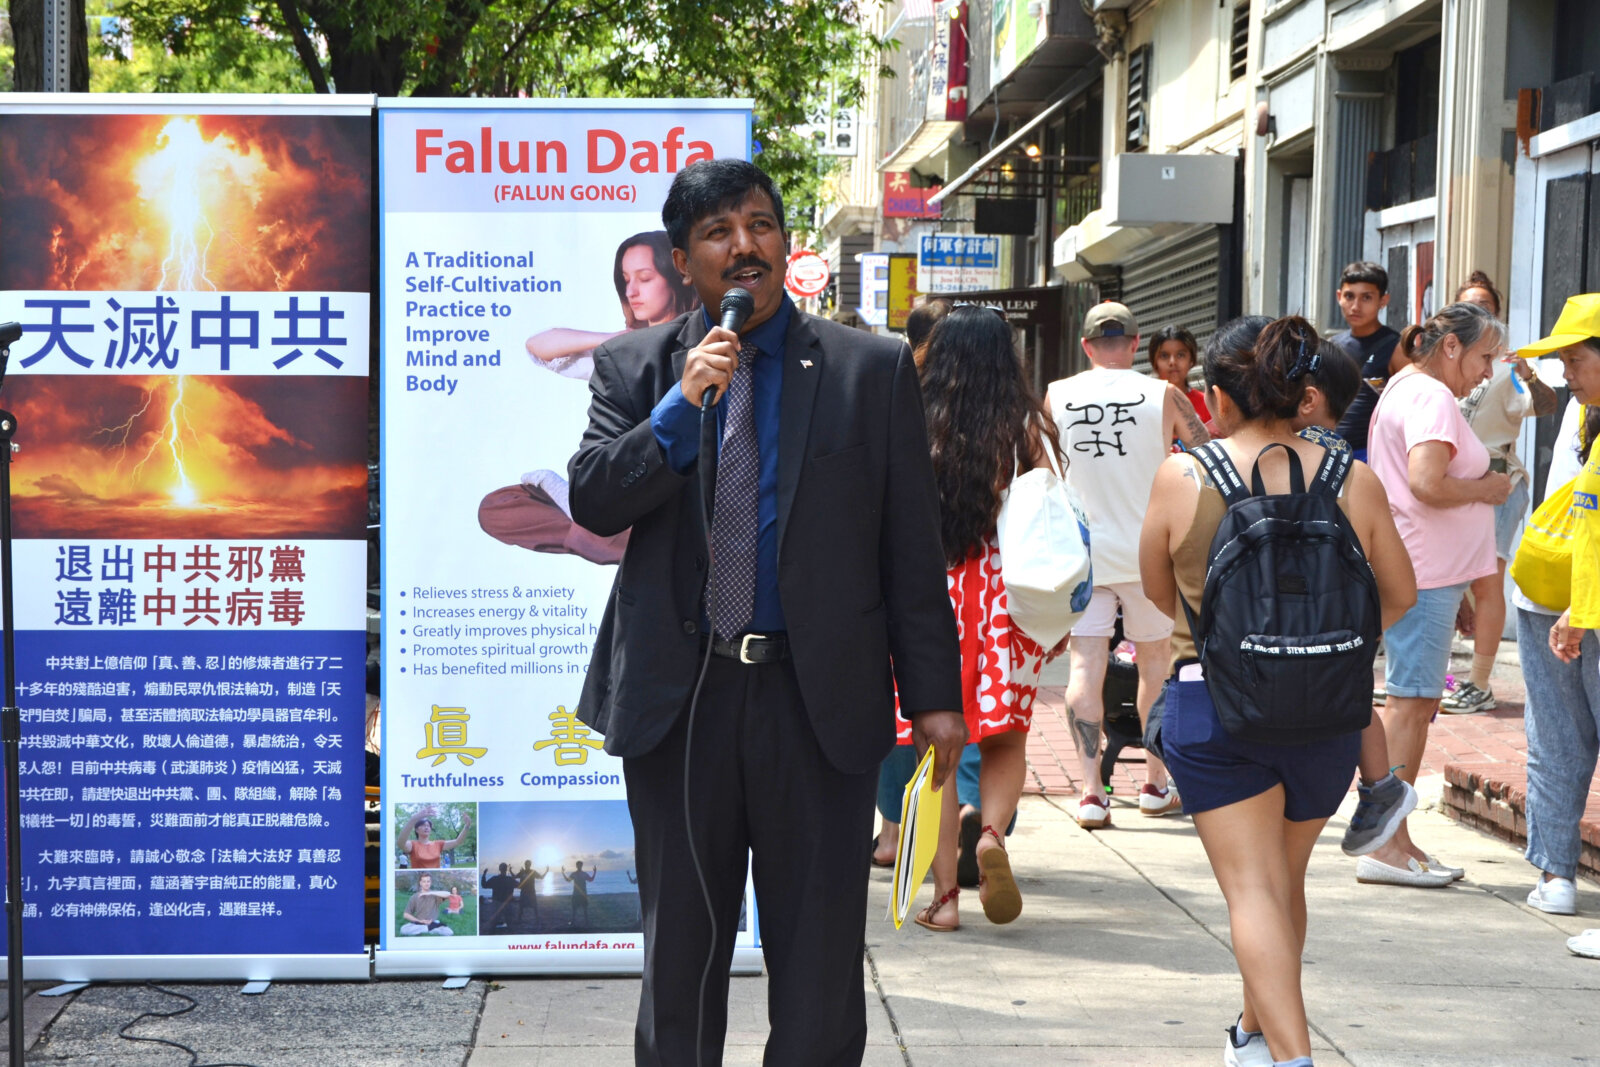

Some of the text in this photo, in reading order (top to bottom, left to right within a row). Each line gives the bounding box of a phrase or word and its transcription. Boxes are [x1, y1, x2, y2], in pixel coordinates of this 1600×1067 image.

[416, 126, 714, 173] Falun Dafa
[495, 185, 636, 202] (FALUN GONG)
[406, 251, 533, 268] A Traditional
[406, 276, 561, 292] Self-Cultivation
[406, 300, 511, 317] Practice to
[954, 299, 1038, 310] BNANA LEAF
[19, 296, 347, 371] 天滅中共
[407, 326, 489, 346] Improve
[406, 350, 500, 366] Mind and
[407, 374, 458, 395] Body
[56, 545, 305, 582] 退出中共邪黨
[414, 586, 574, 600] Relieves stress & anxiety
[55, 588, 304, 625] 遠離中共病毒
[414, 604, 587, 620] Increases energy & vitality
[413, 624, 461, 639] Greatly
[465, 625, 527, 638] improves
[532, 623, 584, 639] physical
[414, 644, 477, 656] Promotes
[482, 642, 535, 658] spiritual
[539, 642, 587, 658] growth
[1307, 645, 1331, 654] MADDEN
[414, 664, 437, 675] Has
[442, 662, 506, 675] benefited
[511, 662, 563, 674] millions
[568, 662, 579, 673] in
[533, 705, 606, 766] 善
[401, 771, 619, 789] Truthfulness Compassion
